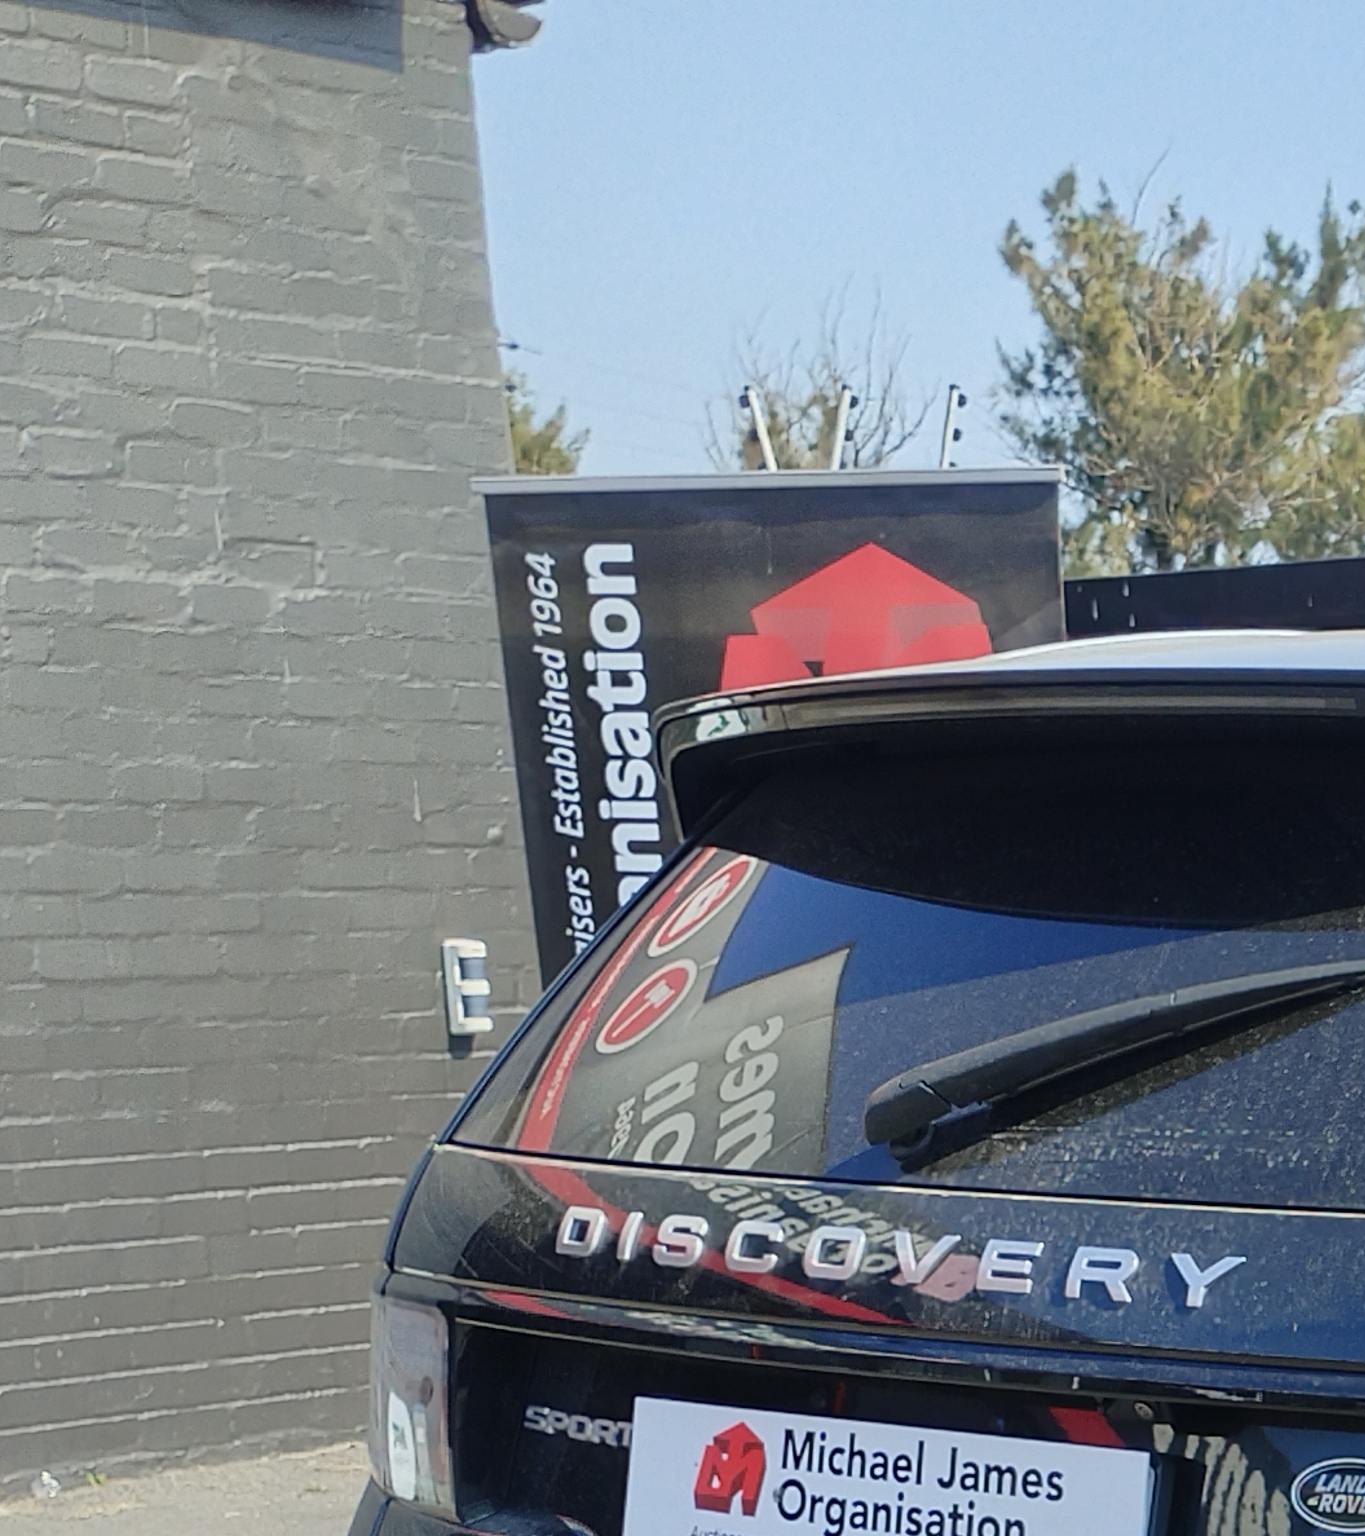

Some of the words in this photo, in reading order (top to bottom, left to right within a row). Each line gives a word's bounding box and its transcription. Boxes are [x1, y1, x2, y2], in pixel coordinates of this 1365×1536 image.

[525, 552, 563, 635] 1964
[533, 645, 585, 839] Established
[556, 1205, 1247, 1307] DISCOVERY
[524, 1405, 632, 1447] SPORT
[781, 1427, 926, 1486] Michael
[936, 1447, 1064, 1502] James
